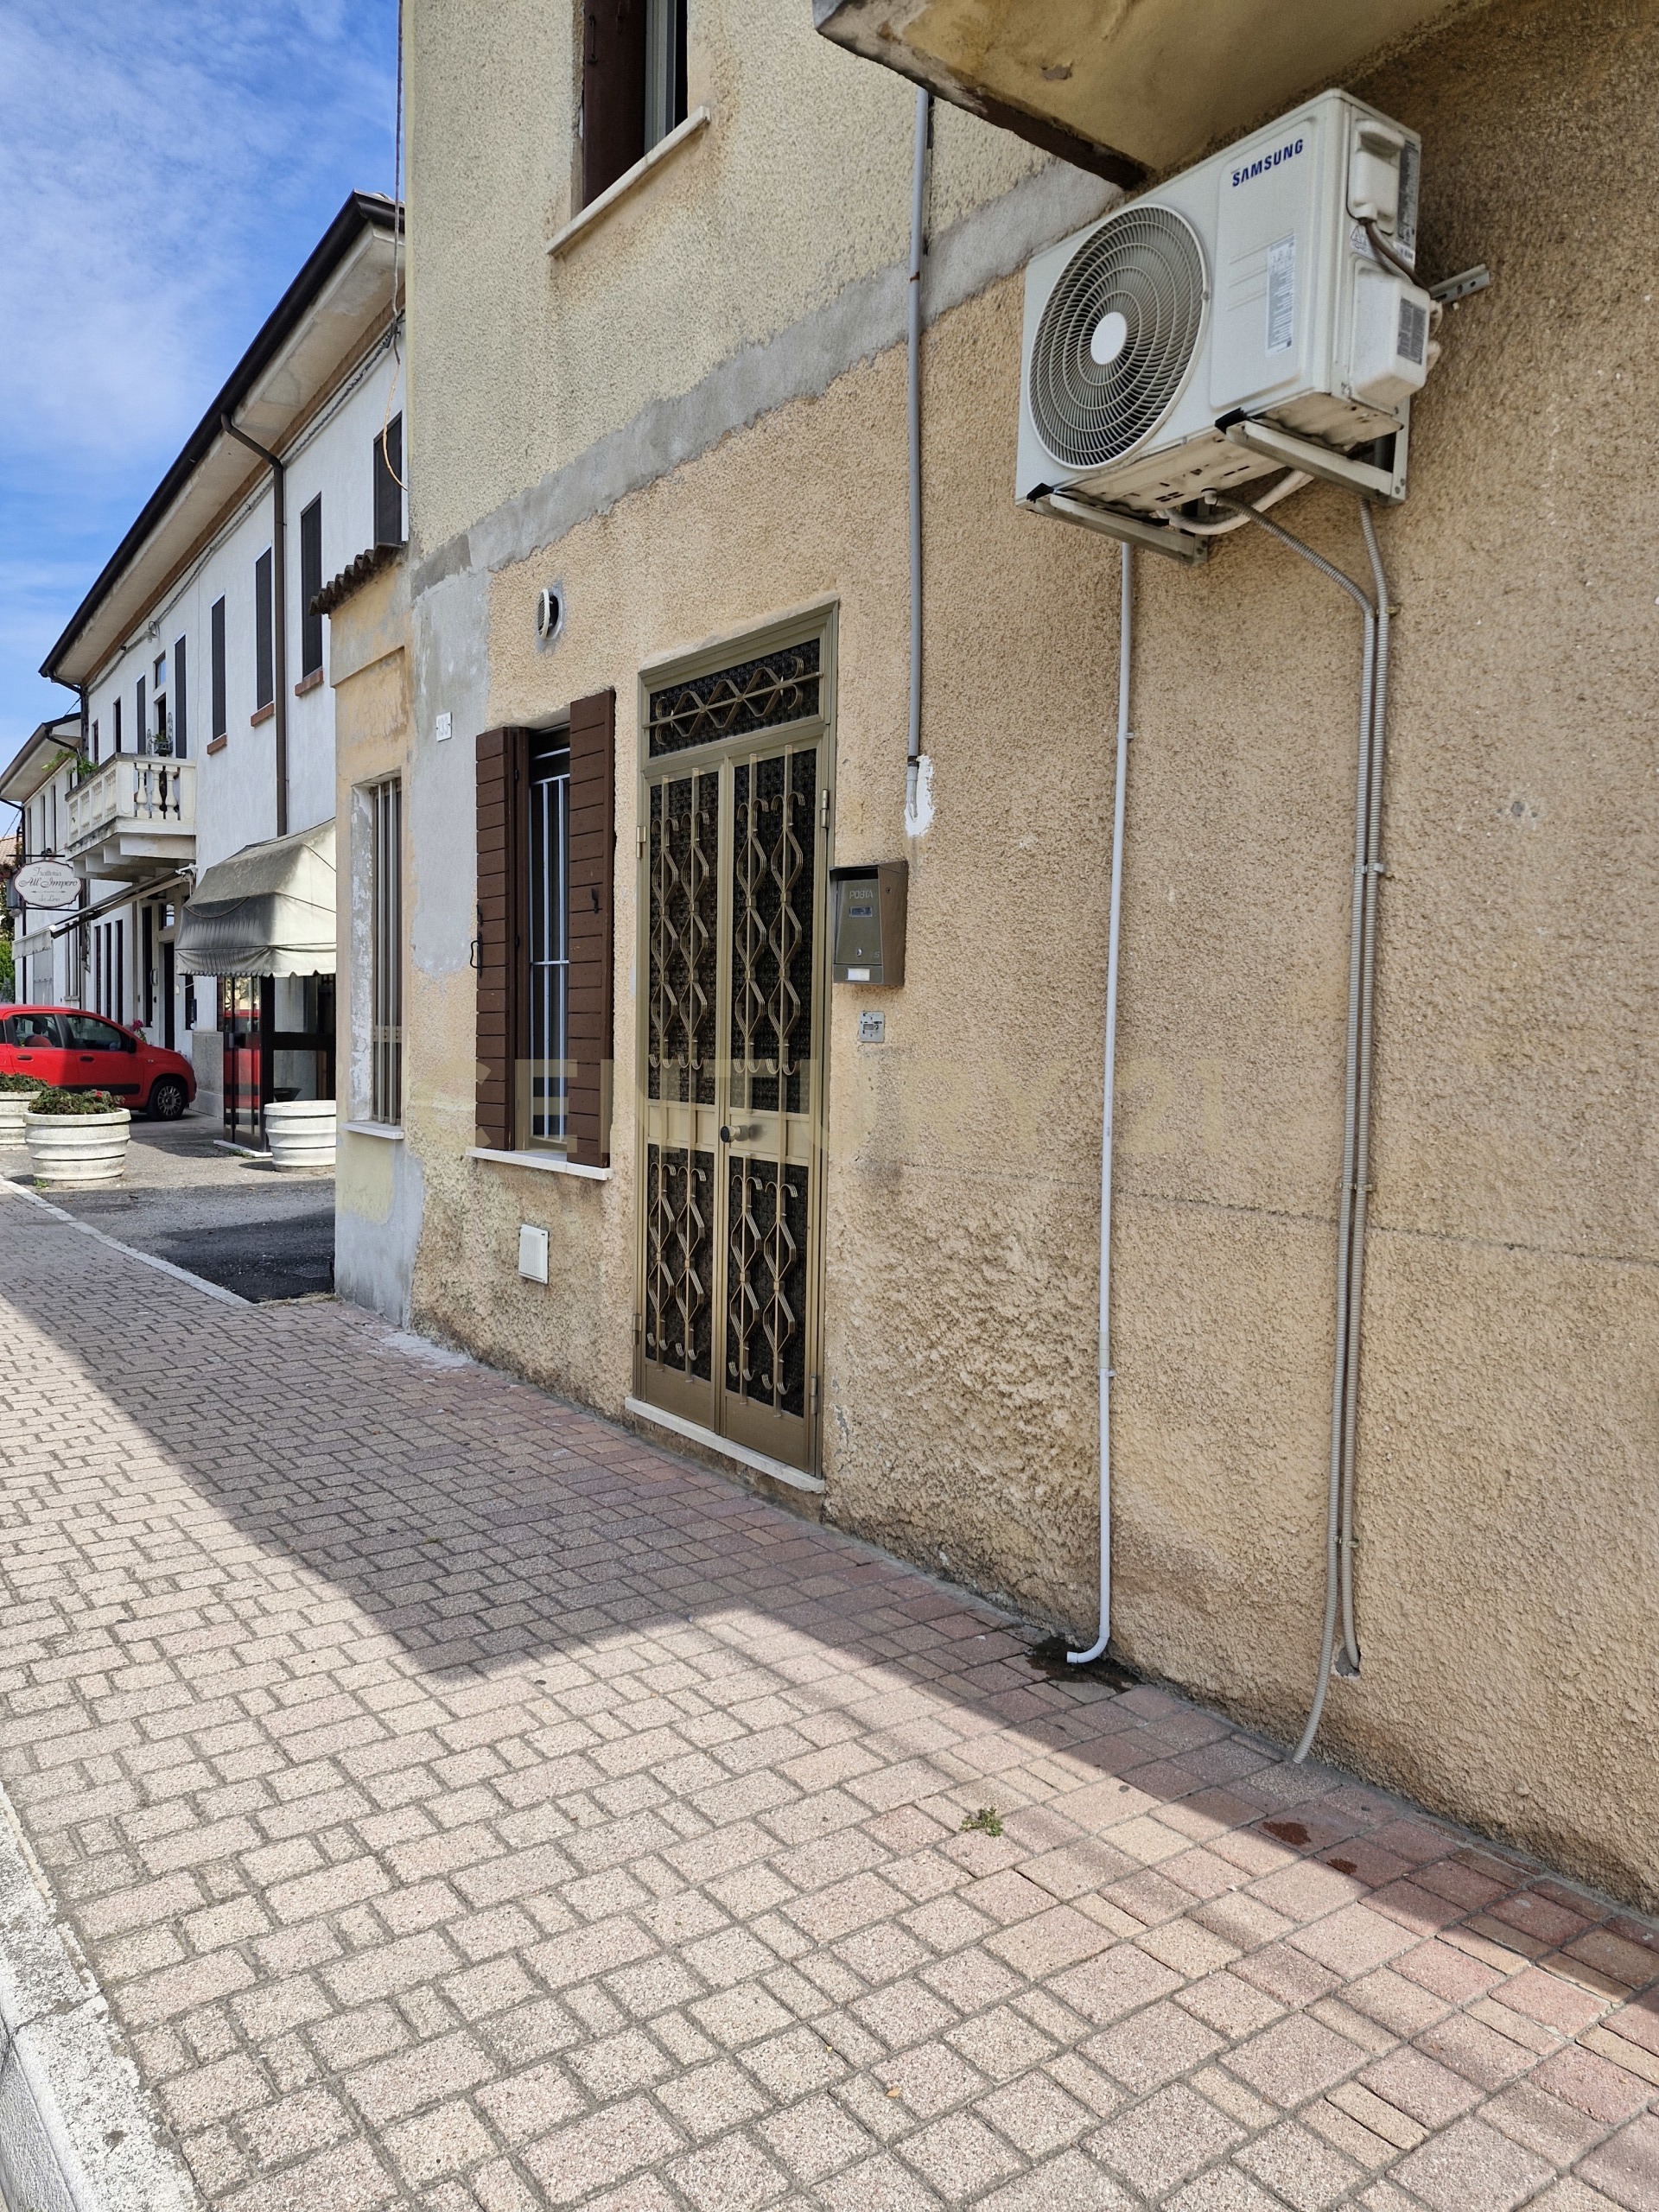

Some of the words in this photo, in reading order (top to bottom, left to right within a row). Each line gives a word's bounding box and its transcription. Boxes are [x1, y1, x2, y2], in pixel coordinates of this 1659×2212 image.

[1232, 138, 1304, 188] SAMSUNG
[33, 867, 62, 877] Trattoria
[849, 888, 874, 899] POSTA
